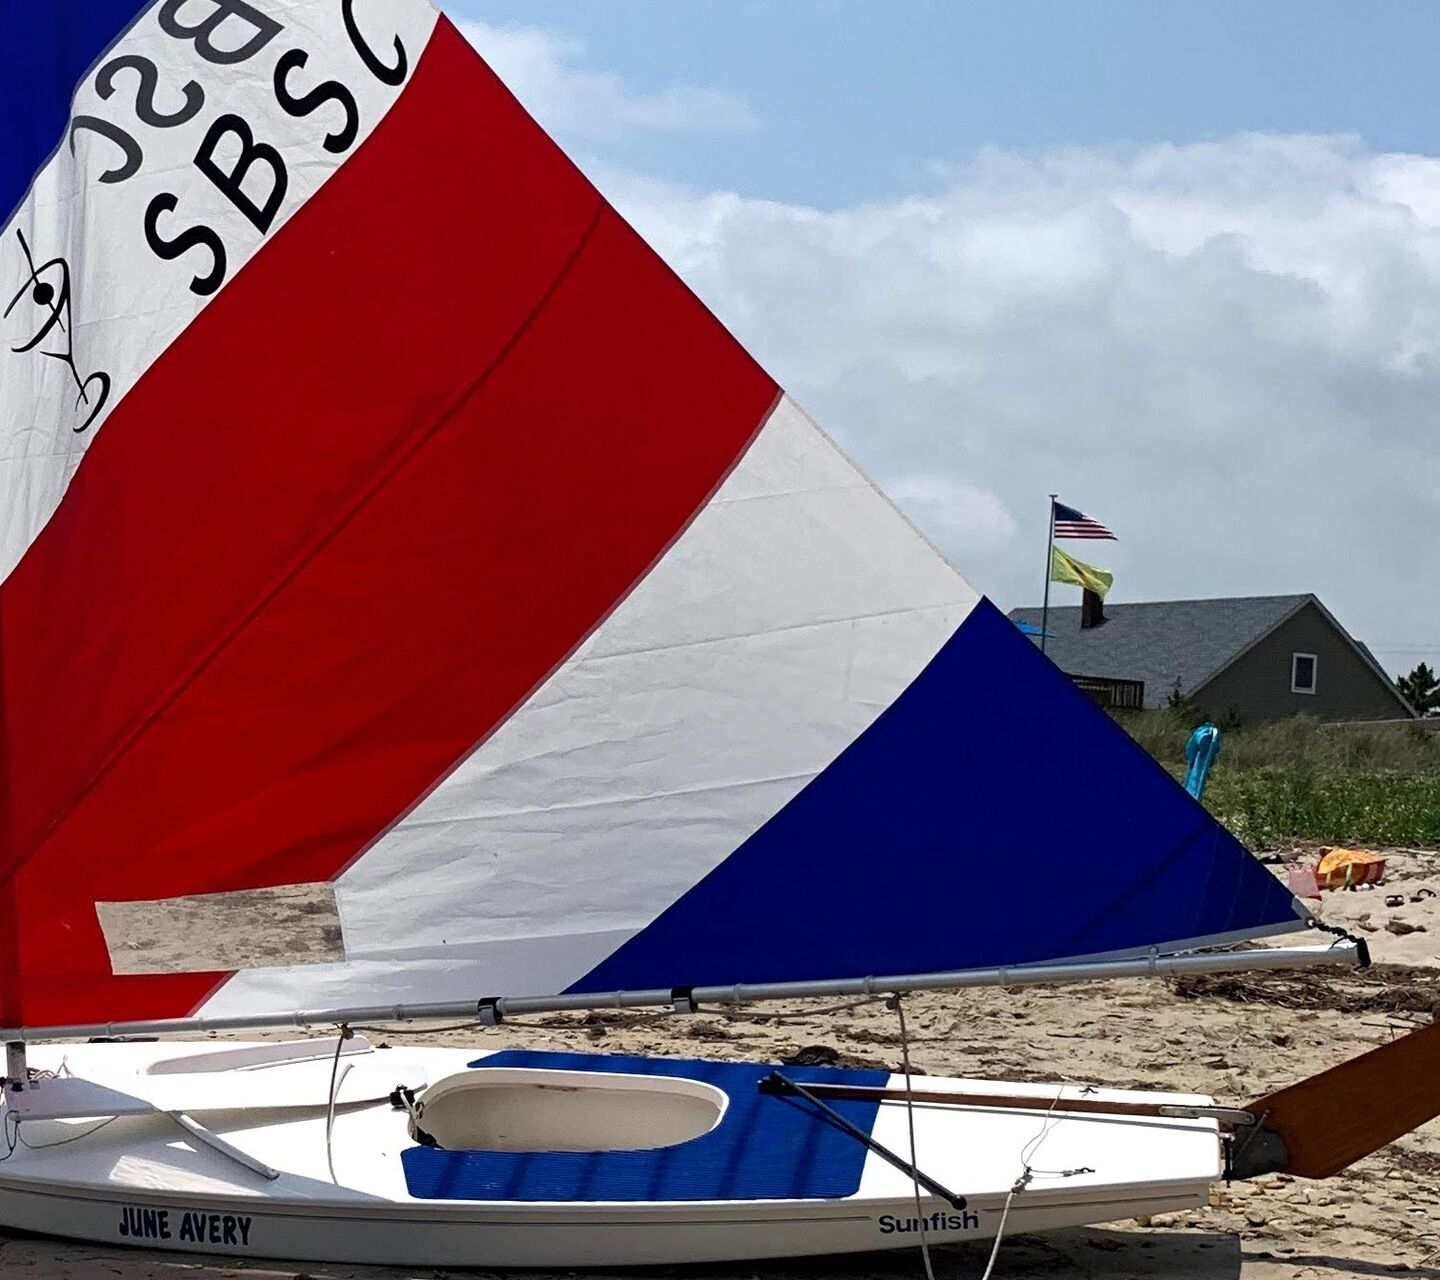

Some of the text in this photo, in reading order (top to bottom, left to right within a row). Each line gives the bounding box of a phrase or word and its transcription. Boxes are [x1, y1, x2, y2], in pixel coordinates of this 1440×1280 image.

[119, 1207, 252, 1246] JUNE AVERY
[878, 1210, 979, 1234] Sunfish
